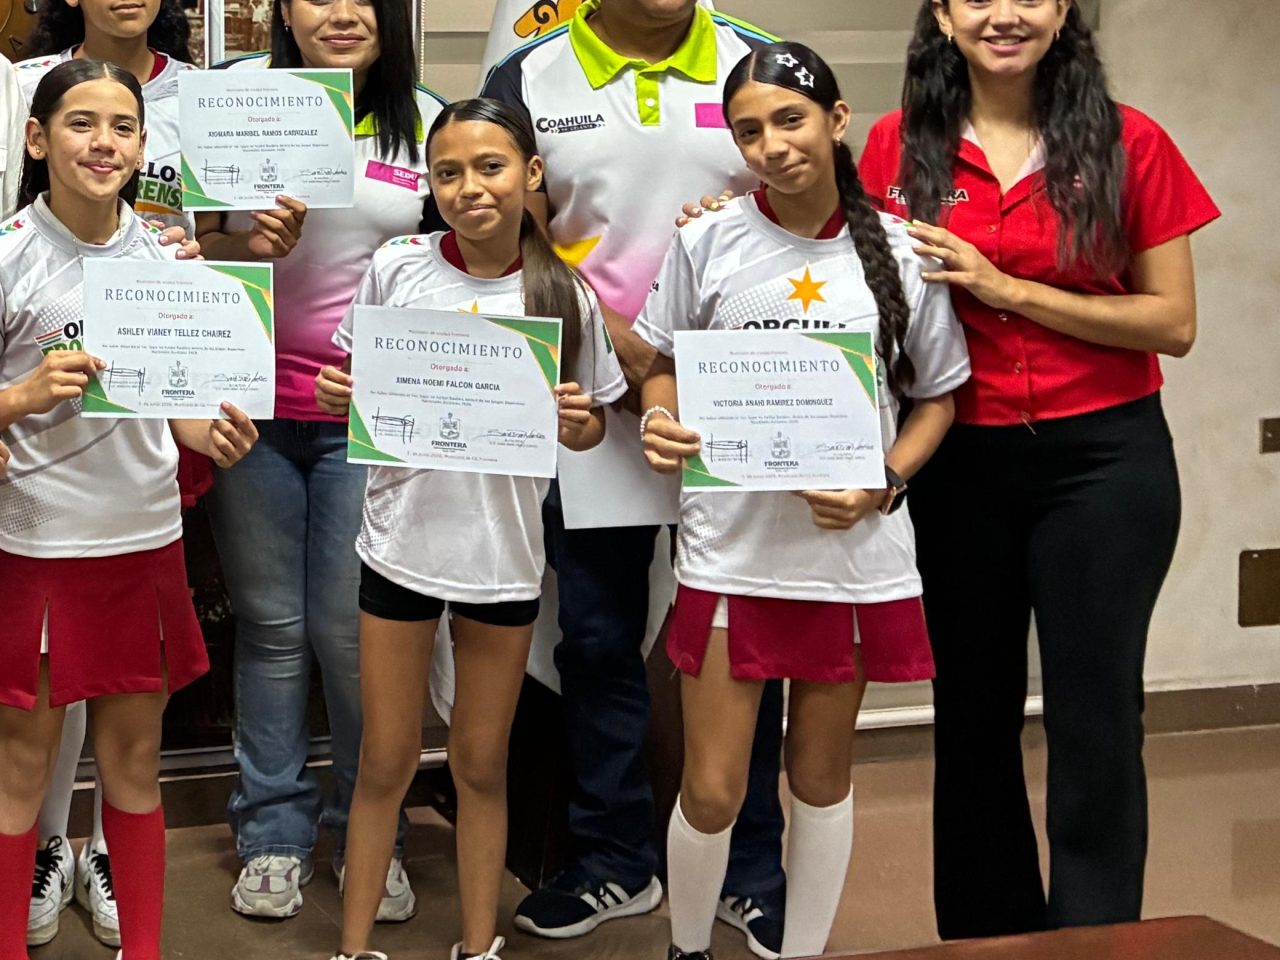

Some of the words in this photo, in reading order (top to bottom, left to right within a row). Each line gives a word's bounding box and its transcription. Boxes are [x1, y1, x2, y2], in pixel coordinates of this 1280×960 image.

[197, 95, 323, 108] RECONOCIMIENTO
[105, 288, 240, 304] RECONOCIMIENTO
[147, 328, 171, 336] VIANEY
[174, 329, 198, 337] TELLEZ
[201, 329, 231, 338] CHAIREZ
[374, 336, 522, 359] RECONOCIMIENTO
[698, 360, 840, 373] RECONOCIMIENTO
[395, 376, 420, 384] XIMENA
[422, 378, 443, 386] NOEMI
[445, 380, 472, 388] FALCON
[475, 382, 500, 390] GARCIA
[431, 440, 467, 448] FRONTERA
